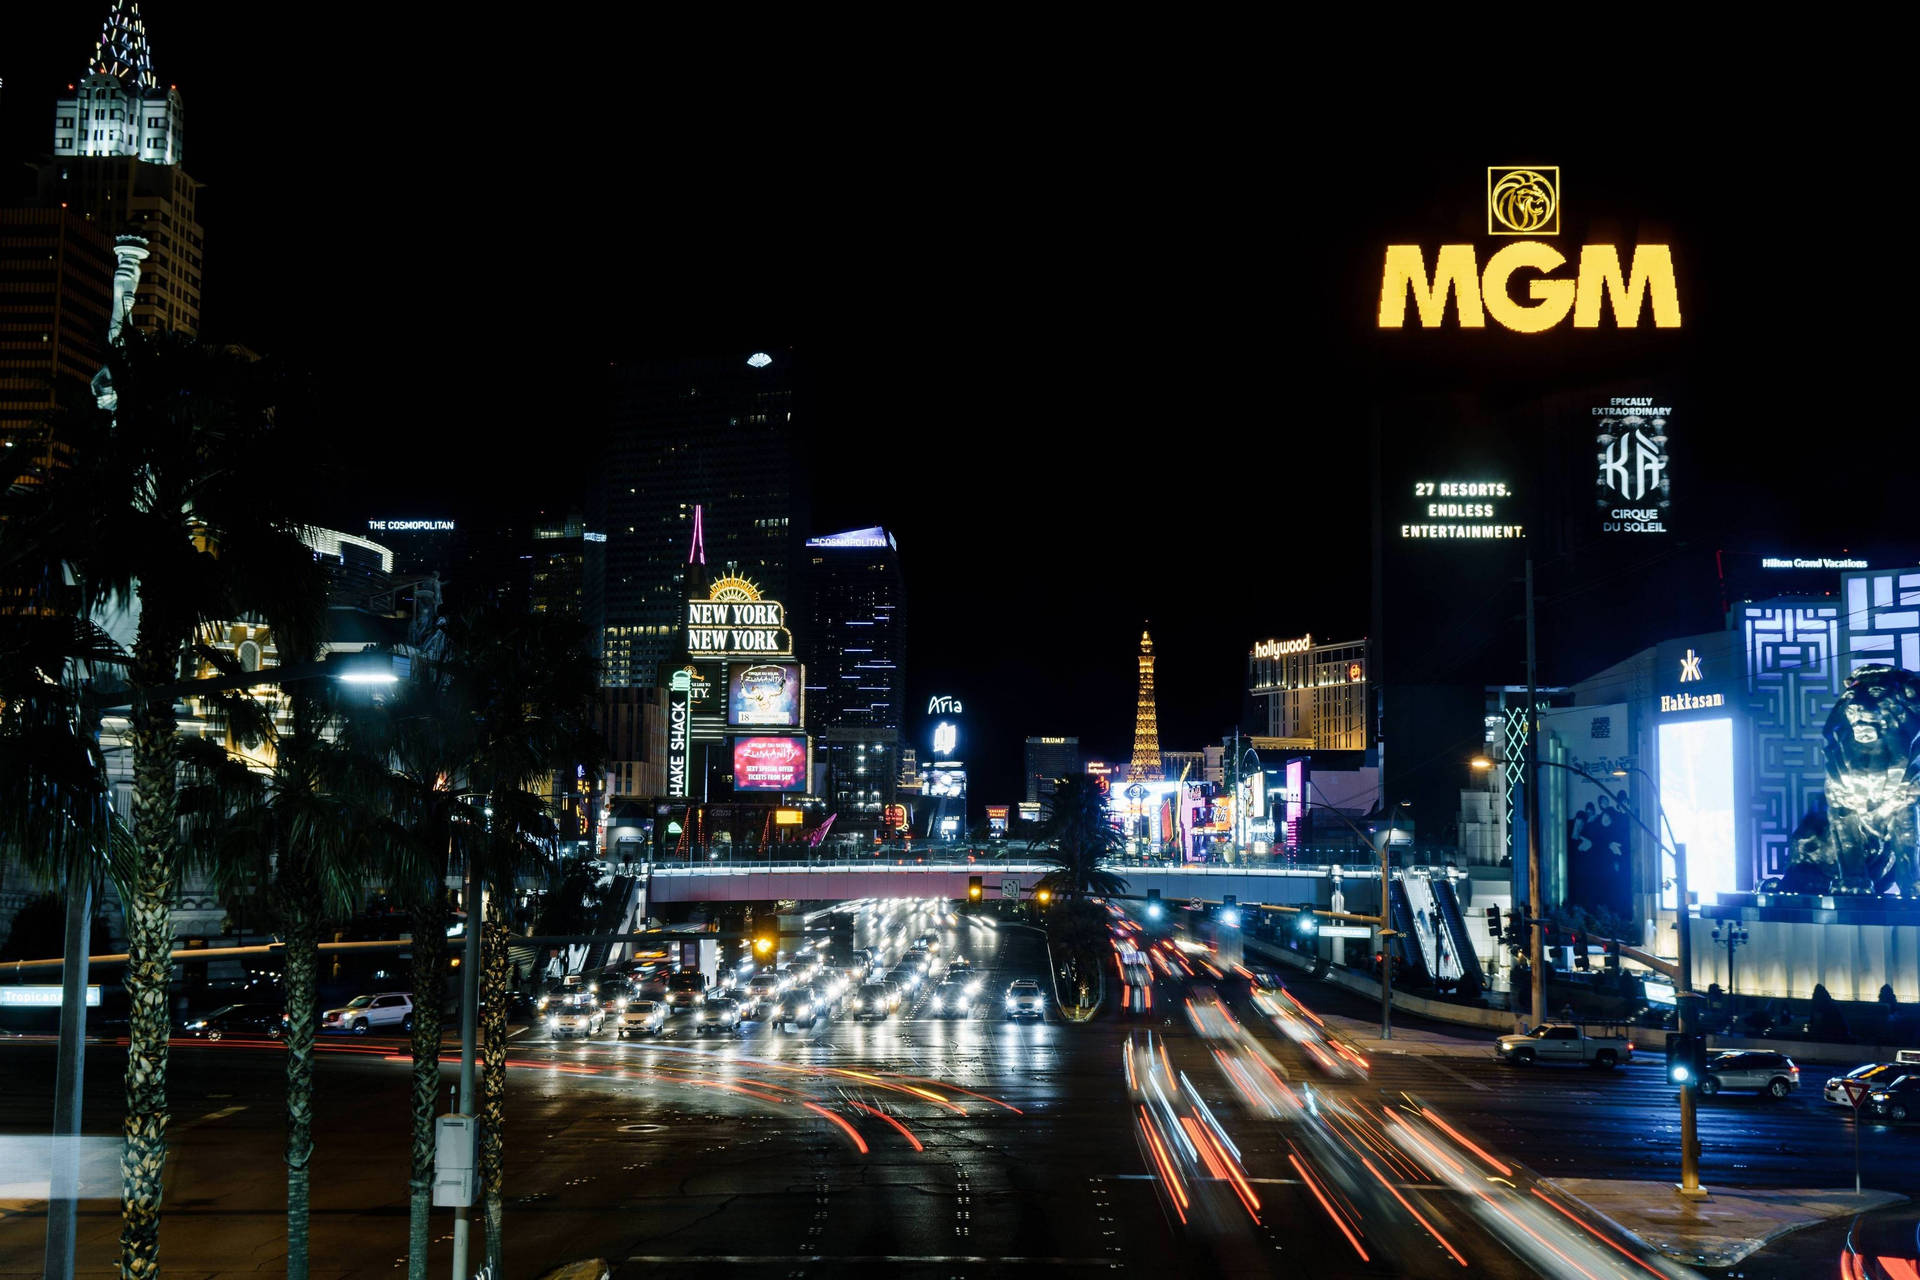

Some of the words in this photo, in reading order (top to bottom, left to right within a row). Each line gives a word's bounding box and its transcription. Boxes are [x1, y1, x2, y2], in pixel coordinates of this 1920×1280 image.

[1378, 240, 1681, 333] MGM
[1610, 398, 1653, 406] EPICALLY
[1592, 407, 1672, 416] EXTRAORDINARY
[1415, 482, 1435, 496] 27
[1440, 482, 1512, 497] RESORTS.
[1428, 503, 1494, 517] ENDLESS
[1611, 509, 1659, 522] CIRQUE
[368, 521, 386, 530] THE
[388, 521, 454, 530] COSMOPOLITAN
[1401, 525, 1526, 538] ENTERTAINMENT.
[1603, 523, 1621, 532] DU
[1624, 523, 1667, 532] SOLEIL
[820, 538, 887, 546] COSMOPOLITAN
[1762, 558, 1793, 568] Hilton
[1793, 558, 1823, 568] Grand
[1823, 558, 1868, 568] Vacations
[689, 604, 729, 624] NEW
[733, 604, 779, 625] YORK
[688, 629, 729, 650] NEW
[732, 629, 779, 650] YORK
[1255, 633, 1311, 660] hollywood
[928, 696, 963, 715] Aria
[1660, 693, 1723, 712] Hakkasan
[671, 701, 686, 751] SHACK
[669, 756, 685, 797] HAKE
